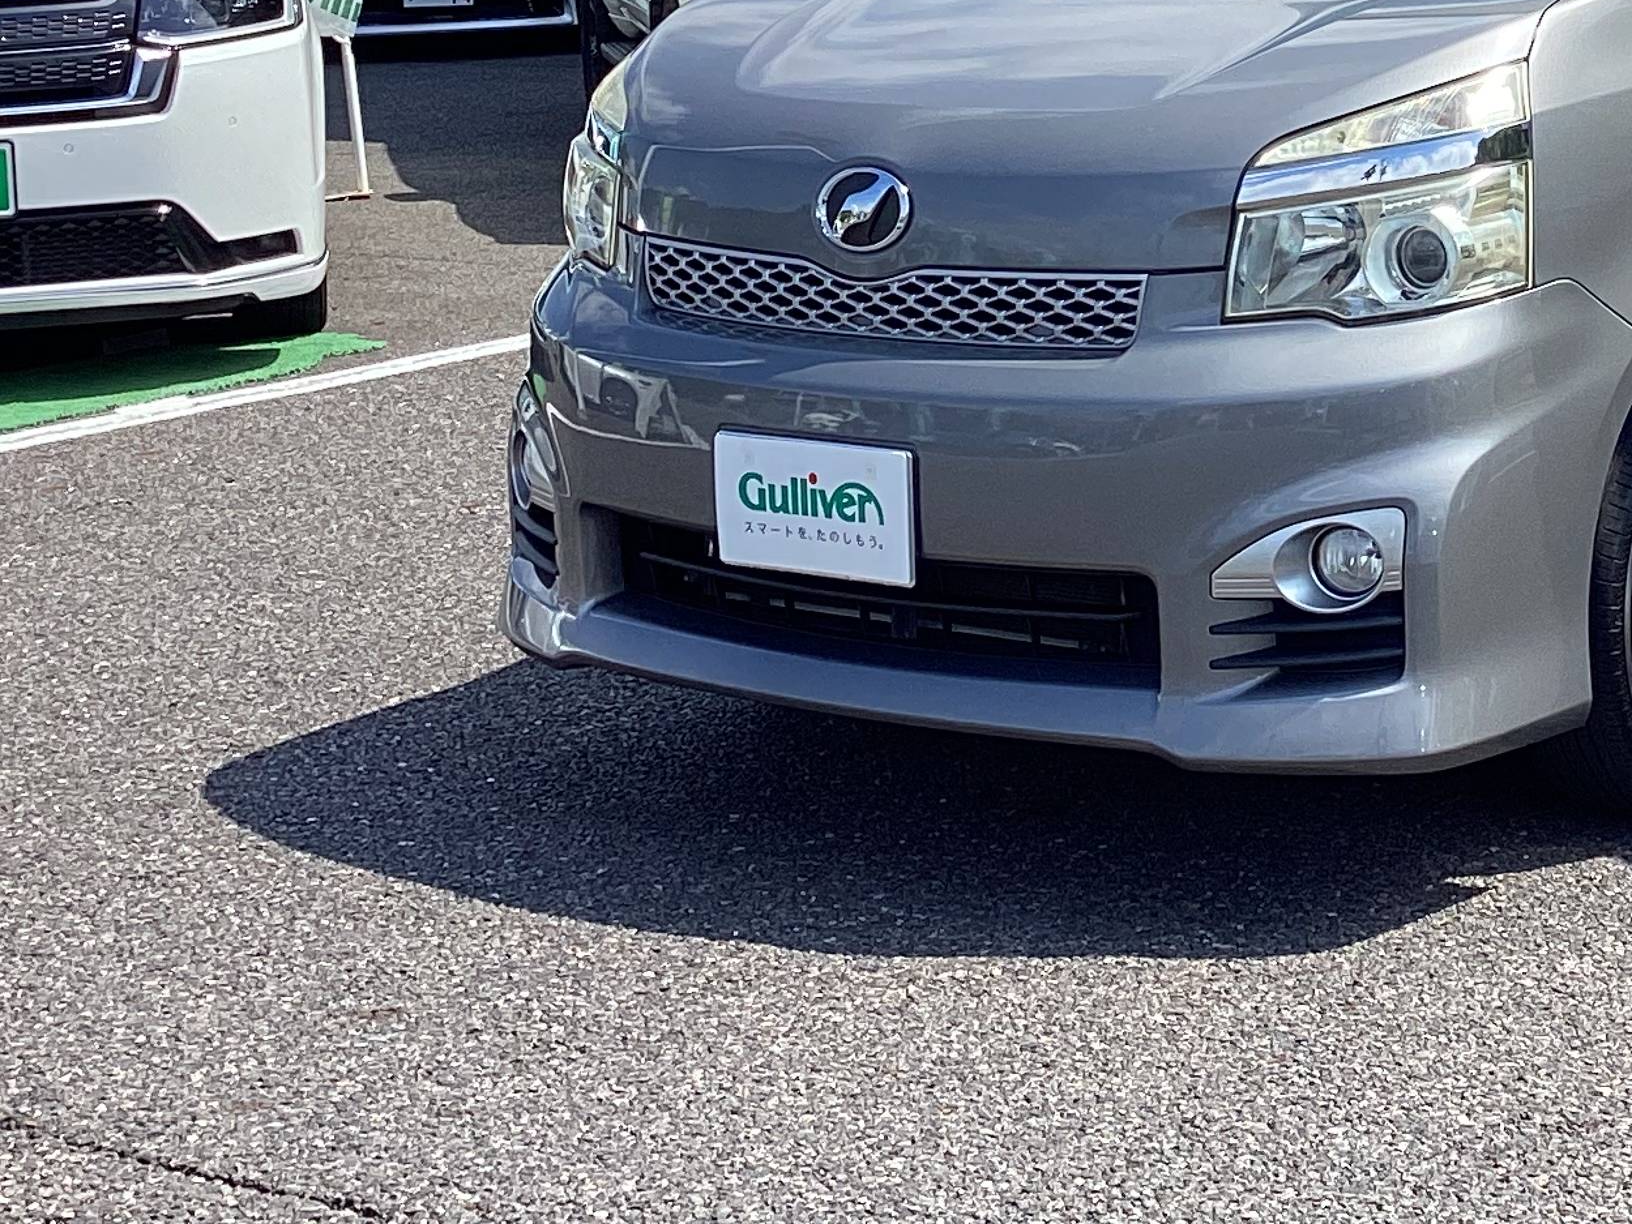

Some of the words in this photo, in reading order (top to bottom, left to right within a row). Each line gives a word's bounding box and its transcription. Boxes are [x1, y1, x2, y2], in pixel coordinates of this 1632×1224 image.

[738, 472, 885, 526] Gulliver
[744, 521, 884, 550] スマートを、たのしもう。
